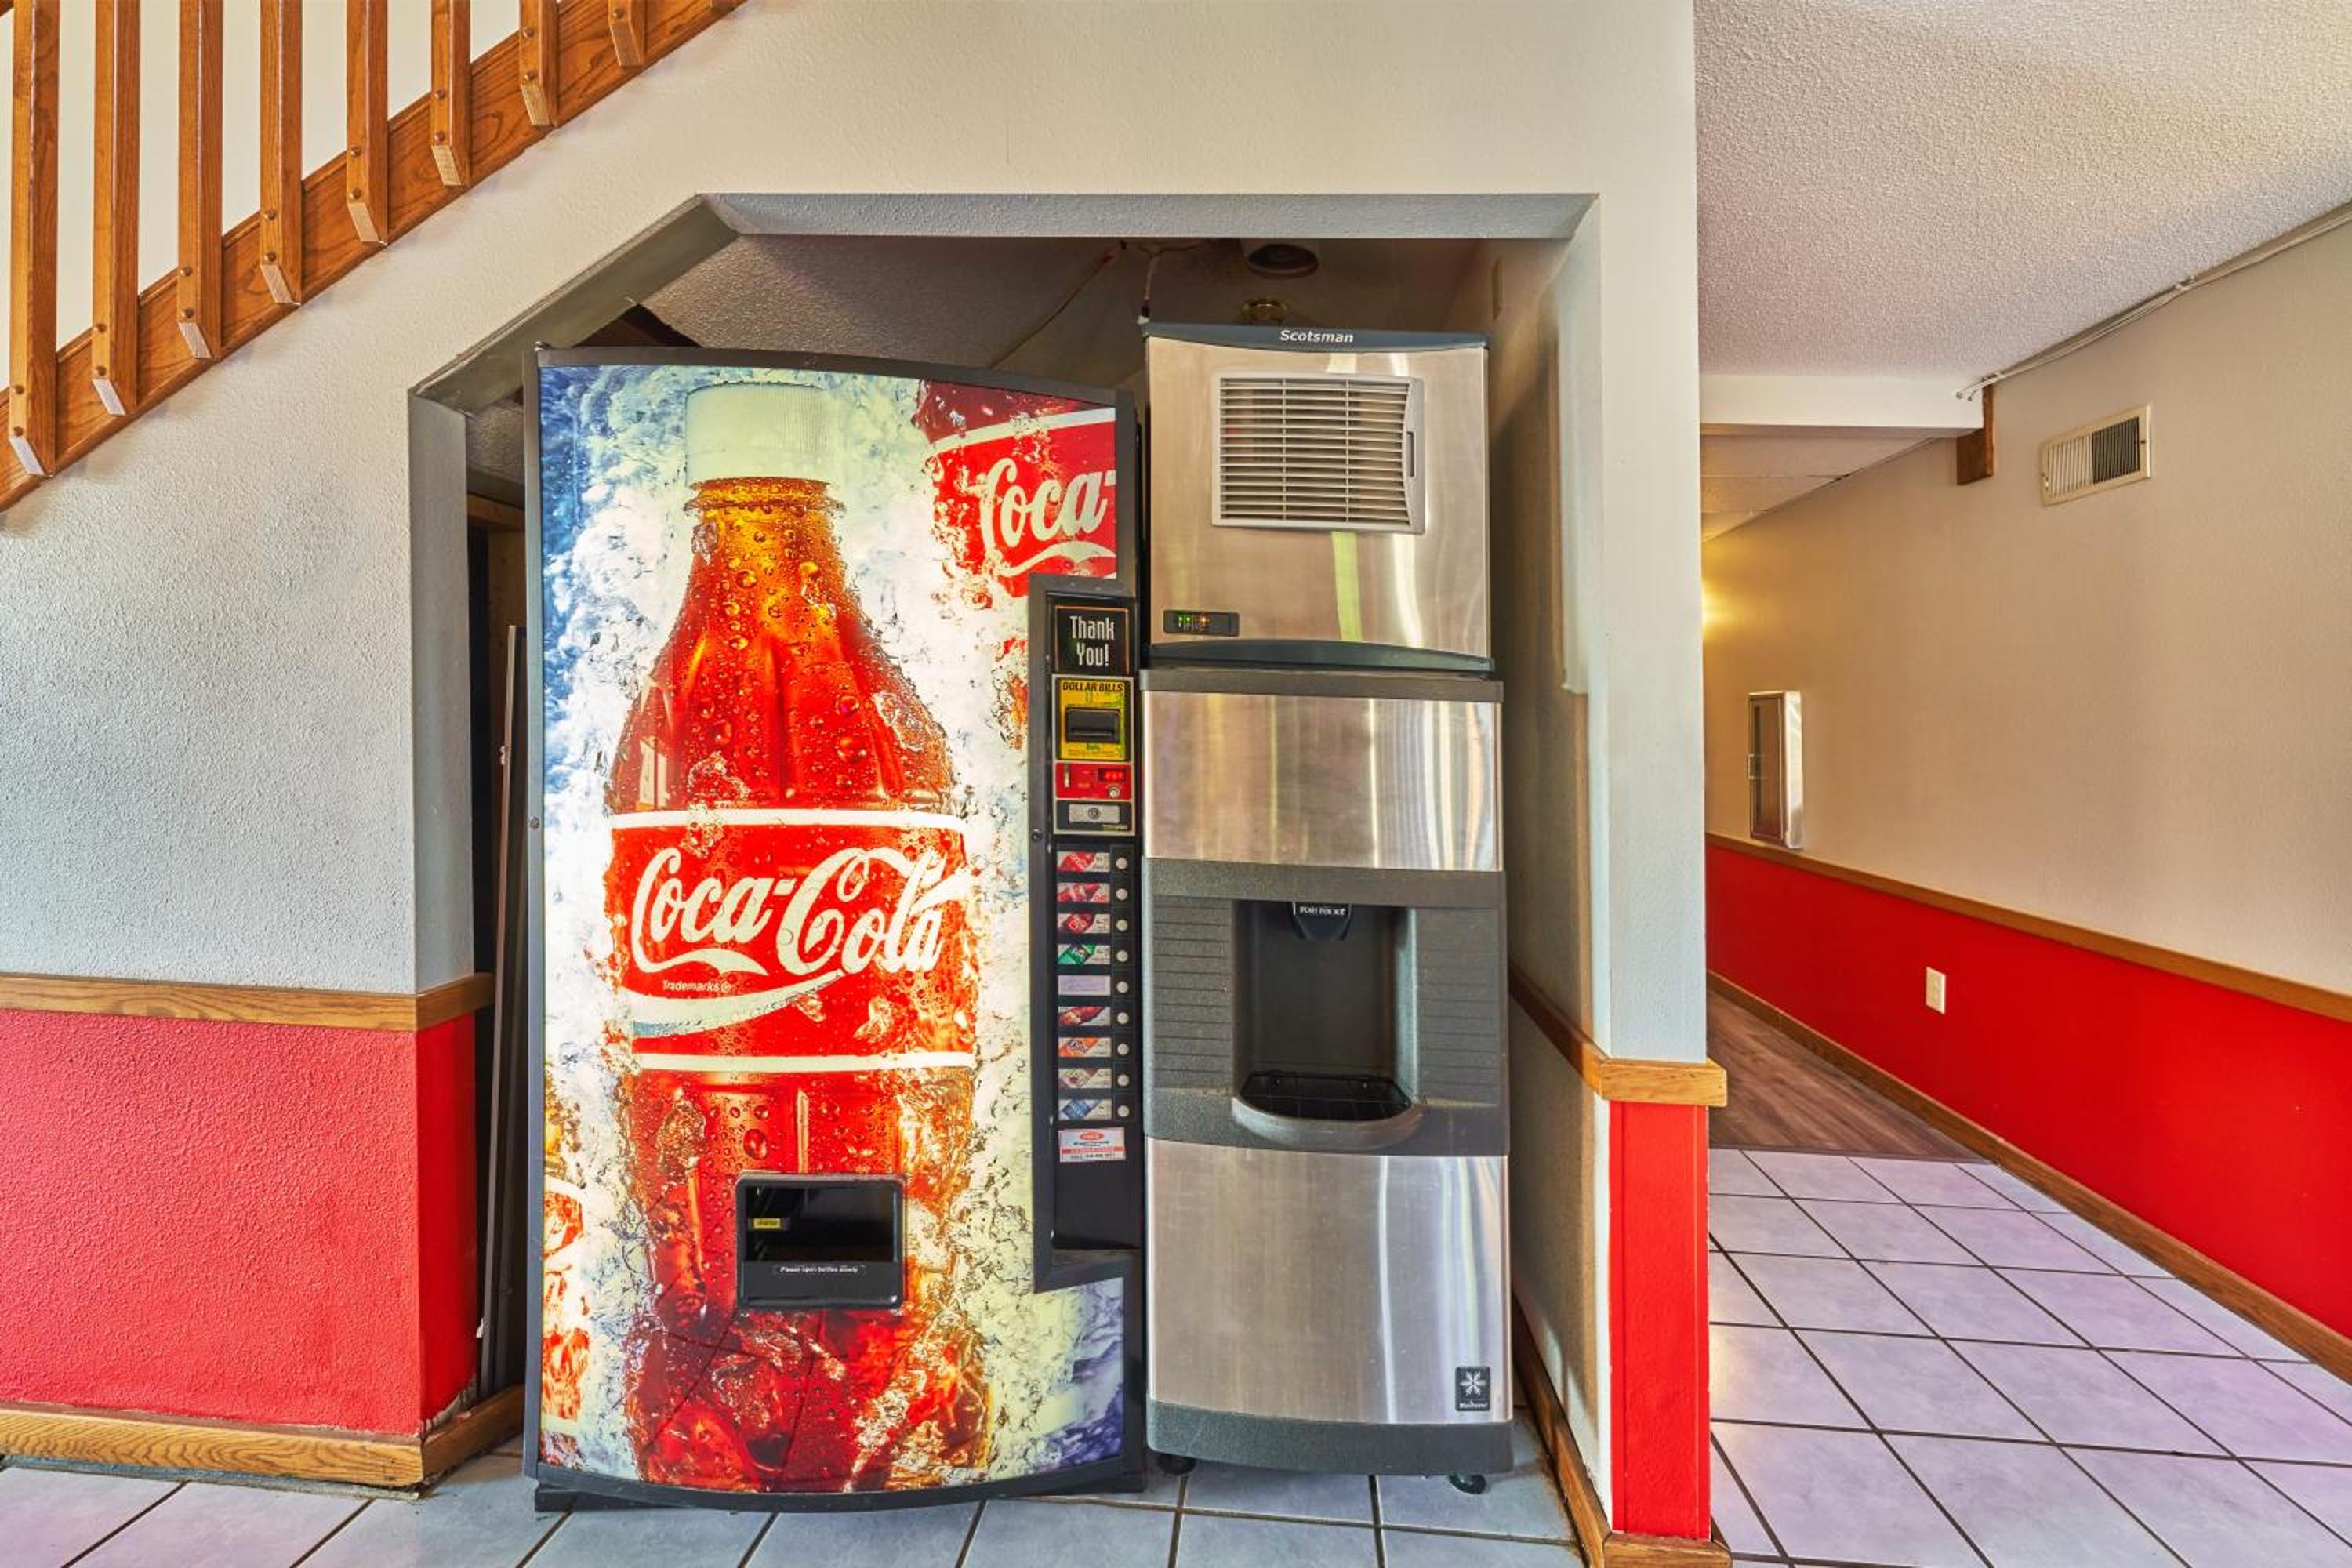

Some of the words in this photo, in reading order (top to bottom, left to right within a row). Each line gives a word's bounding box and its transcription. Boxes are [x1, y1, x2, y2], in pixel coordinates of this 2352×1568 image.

[1279, 329, 1354, 343] Scotsman
[1069, 615, 1115, 641] Thank
[1076, 642, 1109, 666] You!
[1062, 681, 1097, 691] DOLLAR
[1098, 683, 1123, 692] BILLS
[631, 846, 953, 976] Coca-Cola
